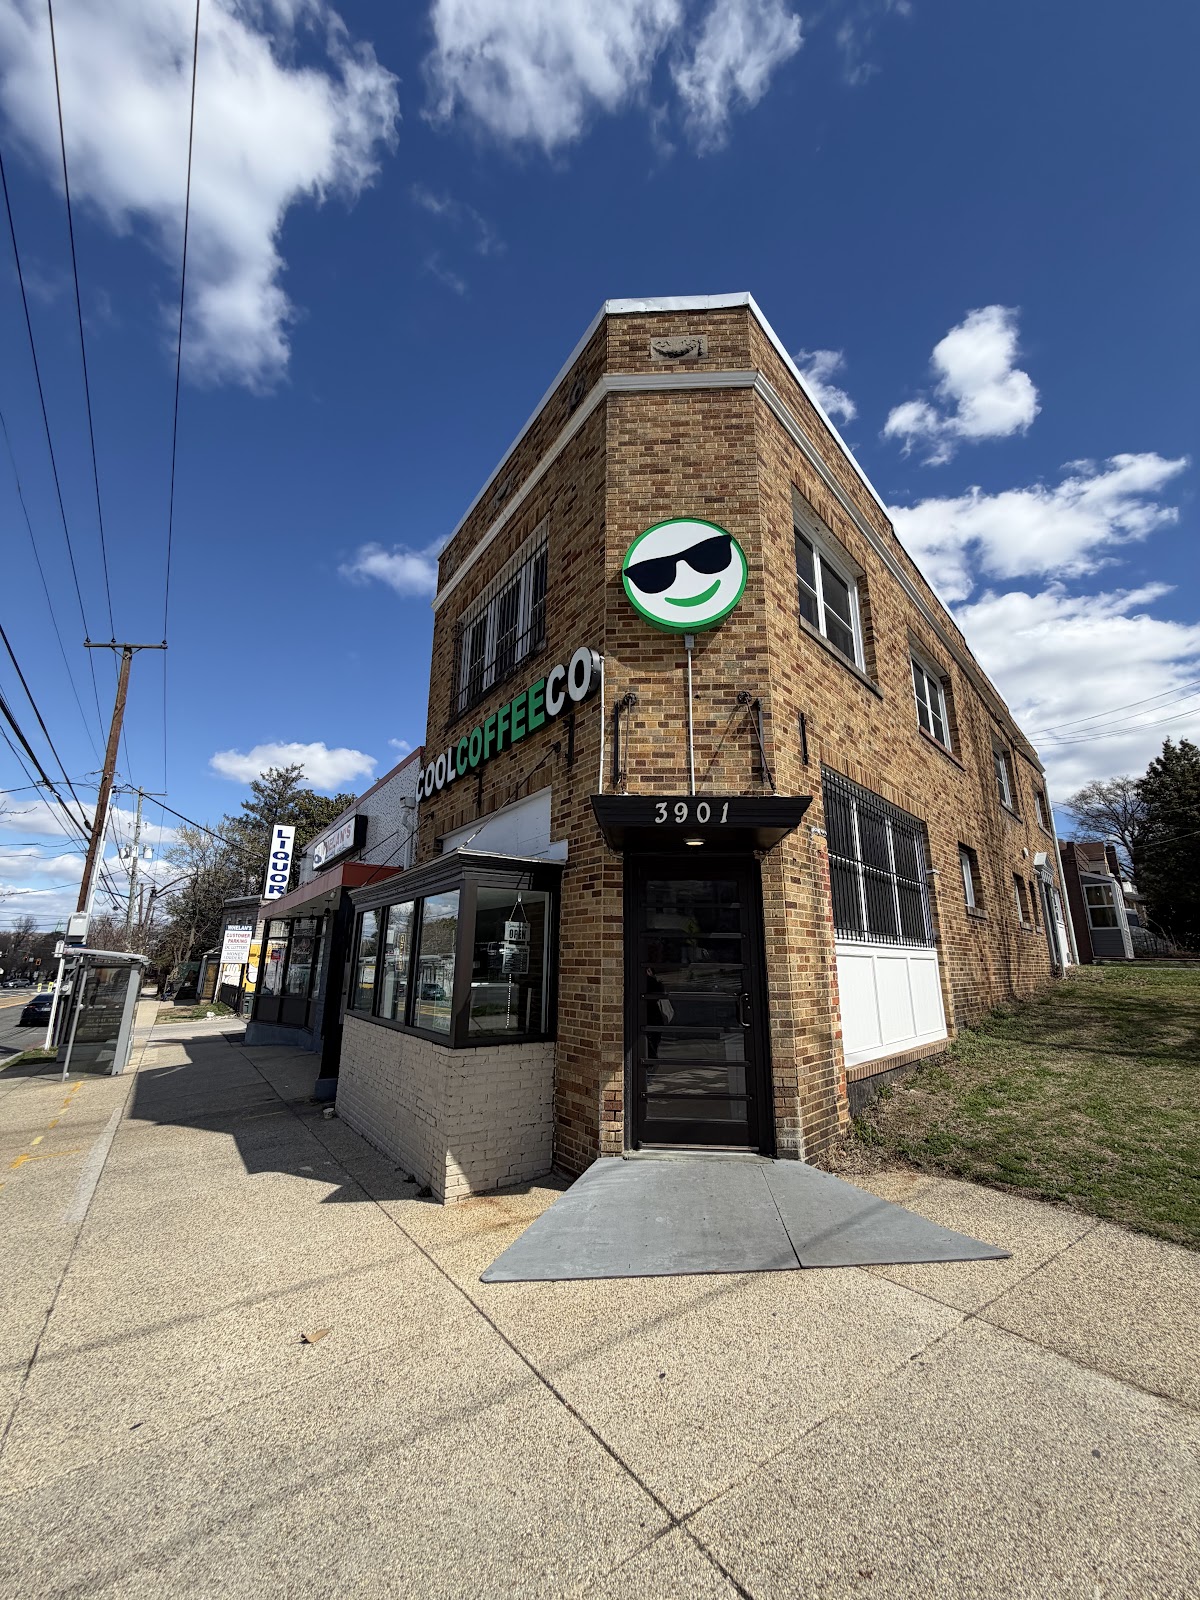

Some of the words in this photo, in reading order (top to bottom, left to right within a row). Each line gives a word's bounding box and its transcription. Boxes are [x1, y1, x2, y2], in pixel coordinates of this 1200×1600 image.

[654, 801, 729, 824] 3901
[268, 829, 290, 894] LIQUOR
[509, 929, 527, 940] OPEN
